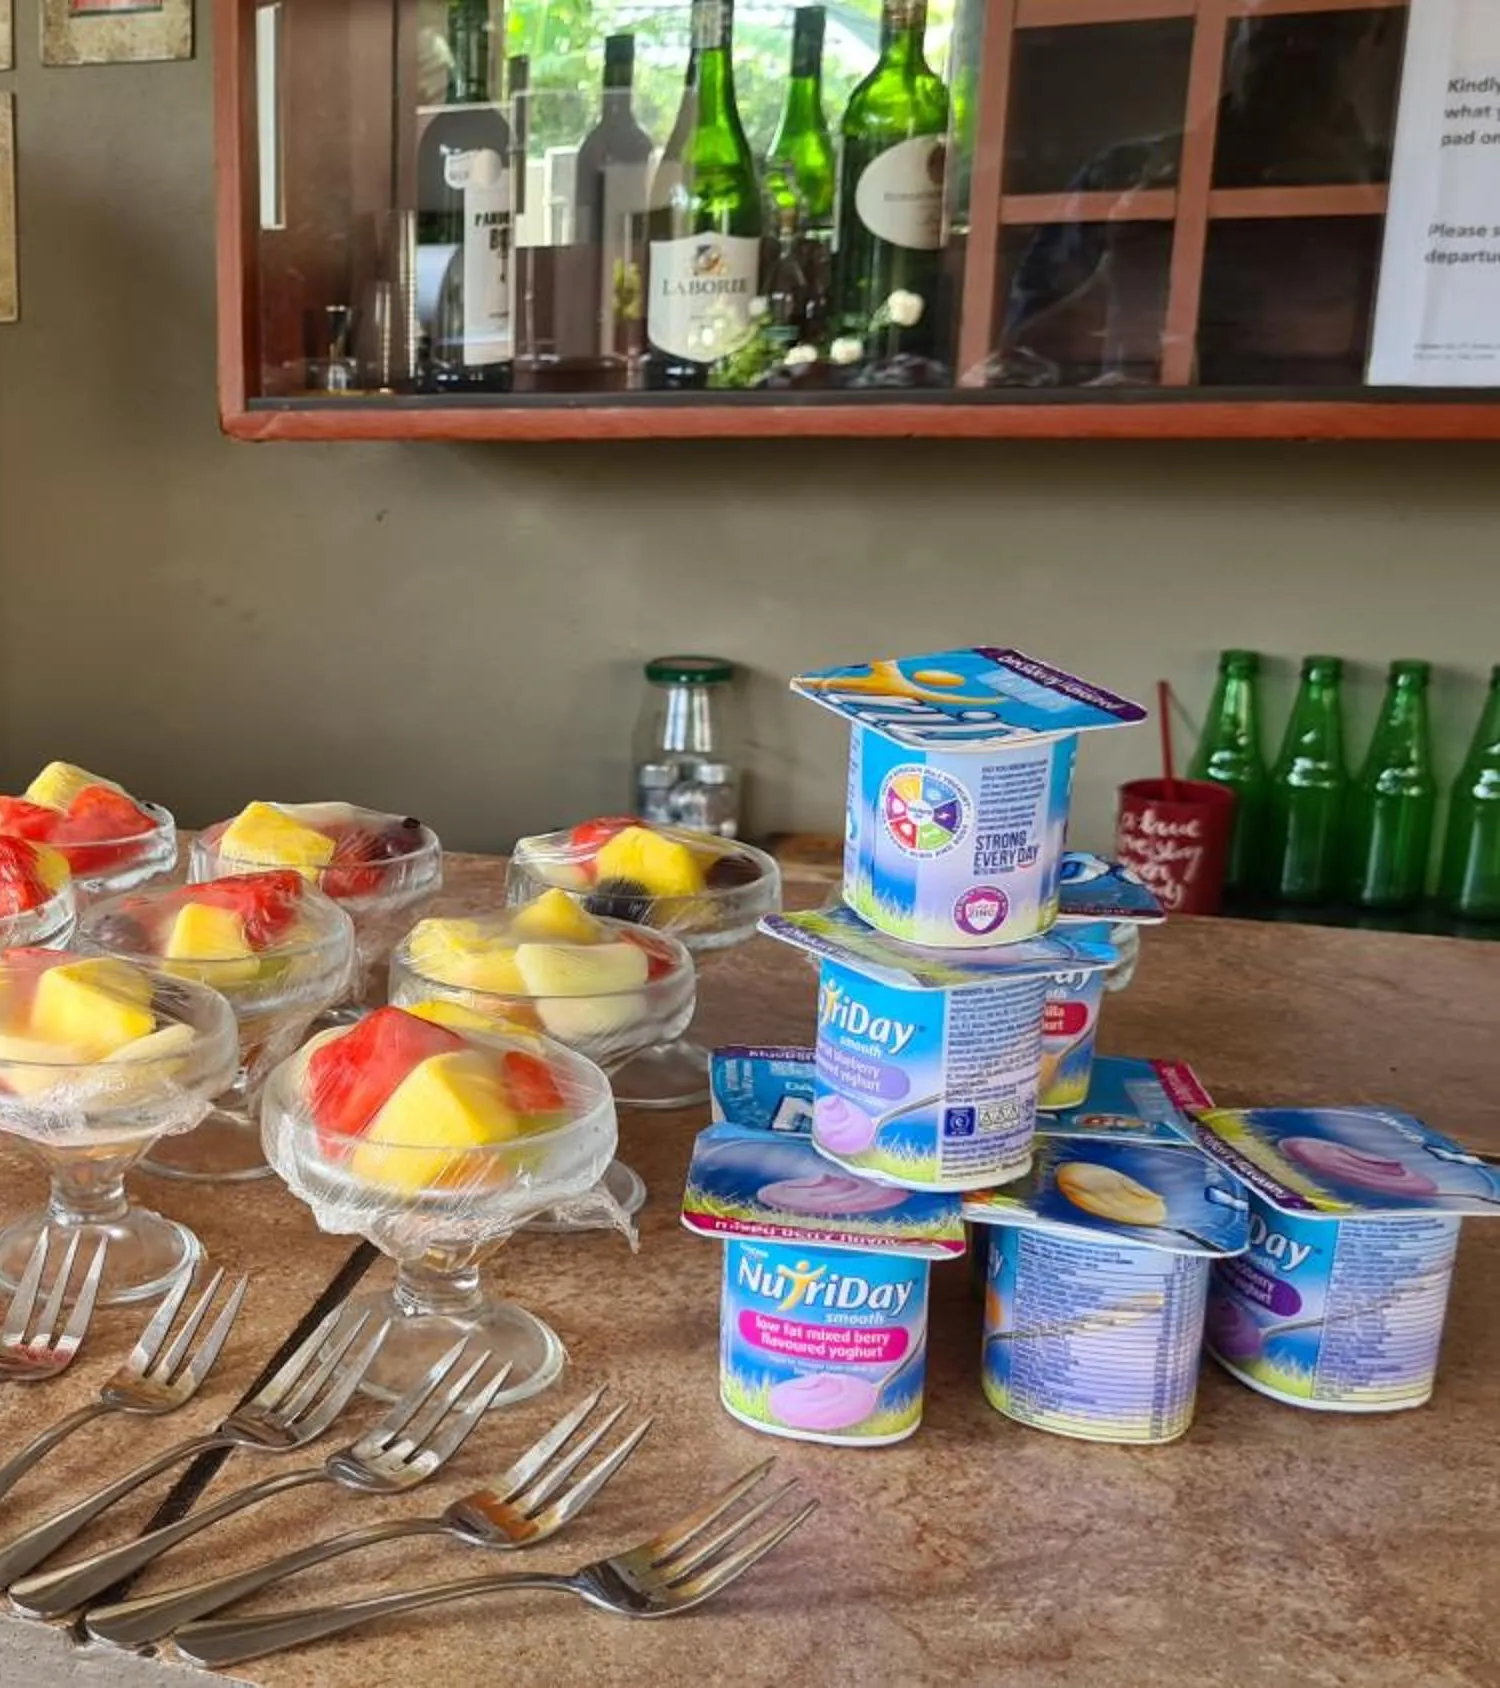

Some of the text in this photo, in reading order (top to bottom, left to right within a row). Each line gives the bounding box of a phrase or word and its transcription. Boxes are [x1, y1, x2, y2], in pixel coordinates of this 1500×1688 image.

[1443, 105, 1491, 119] what
[1440, 131, 1476, 148] pad
[1427, 223, 1488, 238] Please
[1424, 249, 1500, 266] departu
[975, 829, 1028, 851] STRONG
[825, 1312, 886, 1326] smooth
[755, 1314, 891, 1347] low fat mixed berry
[760, 1330, 884, 1361] flavoured yoghurt
